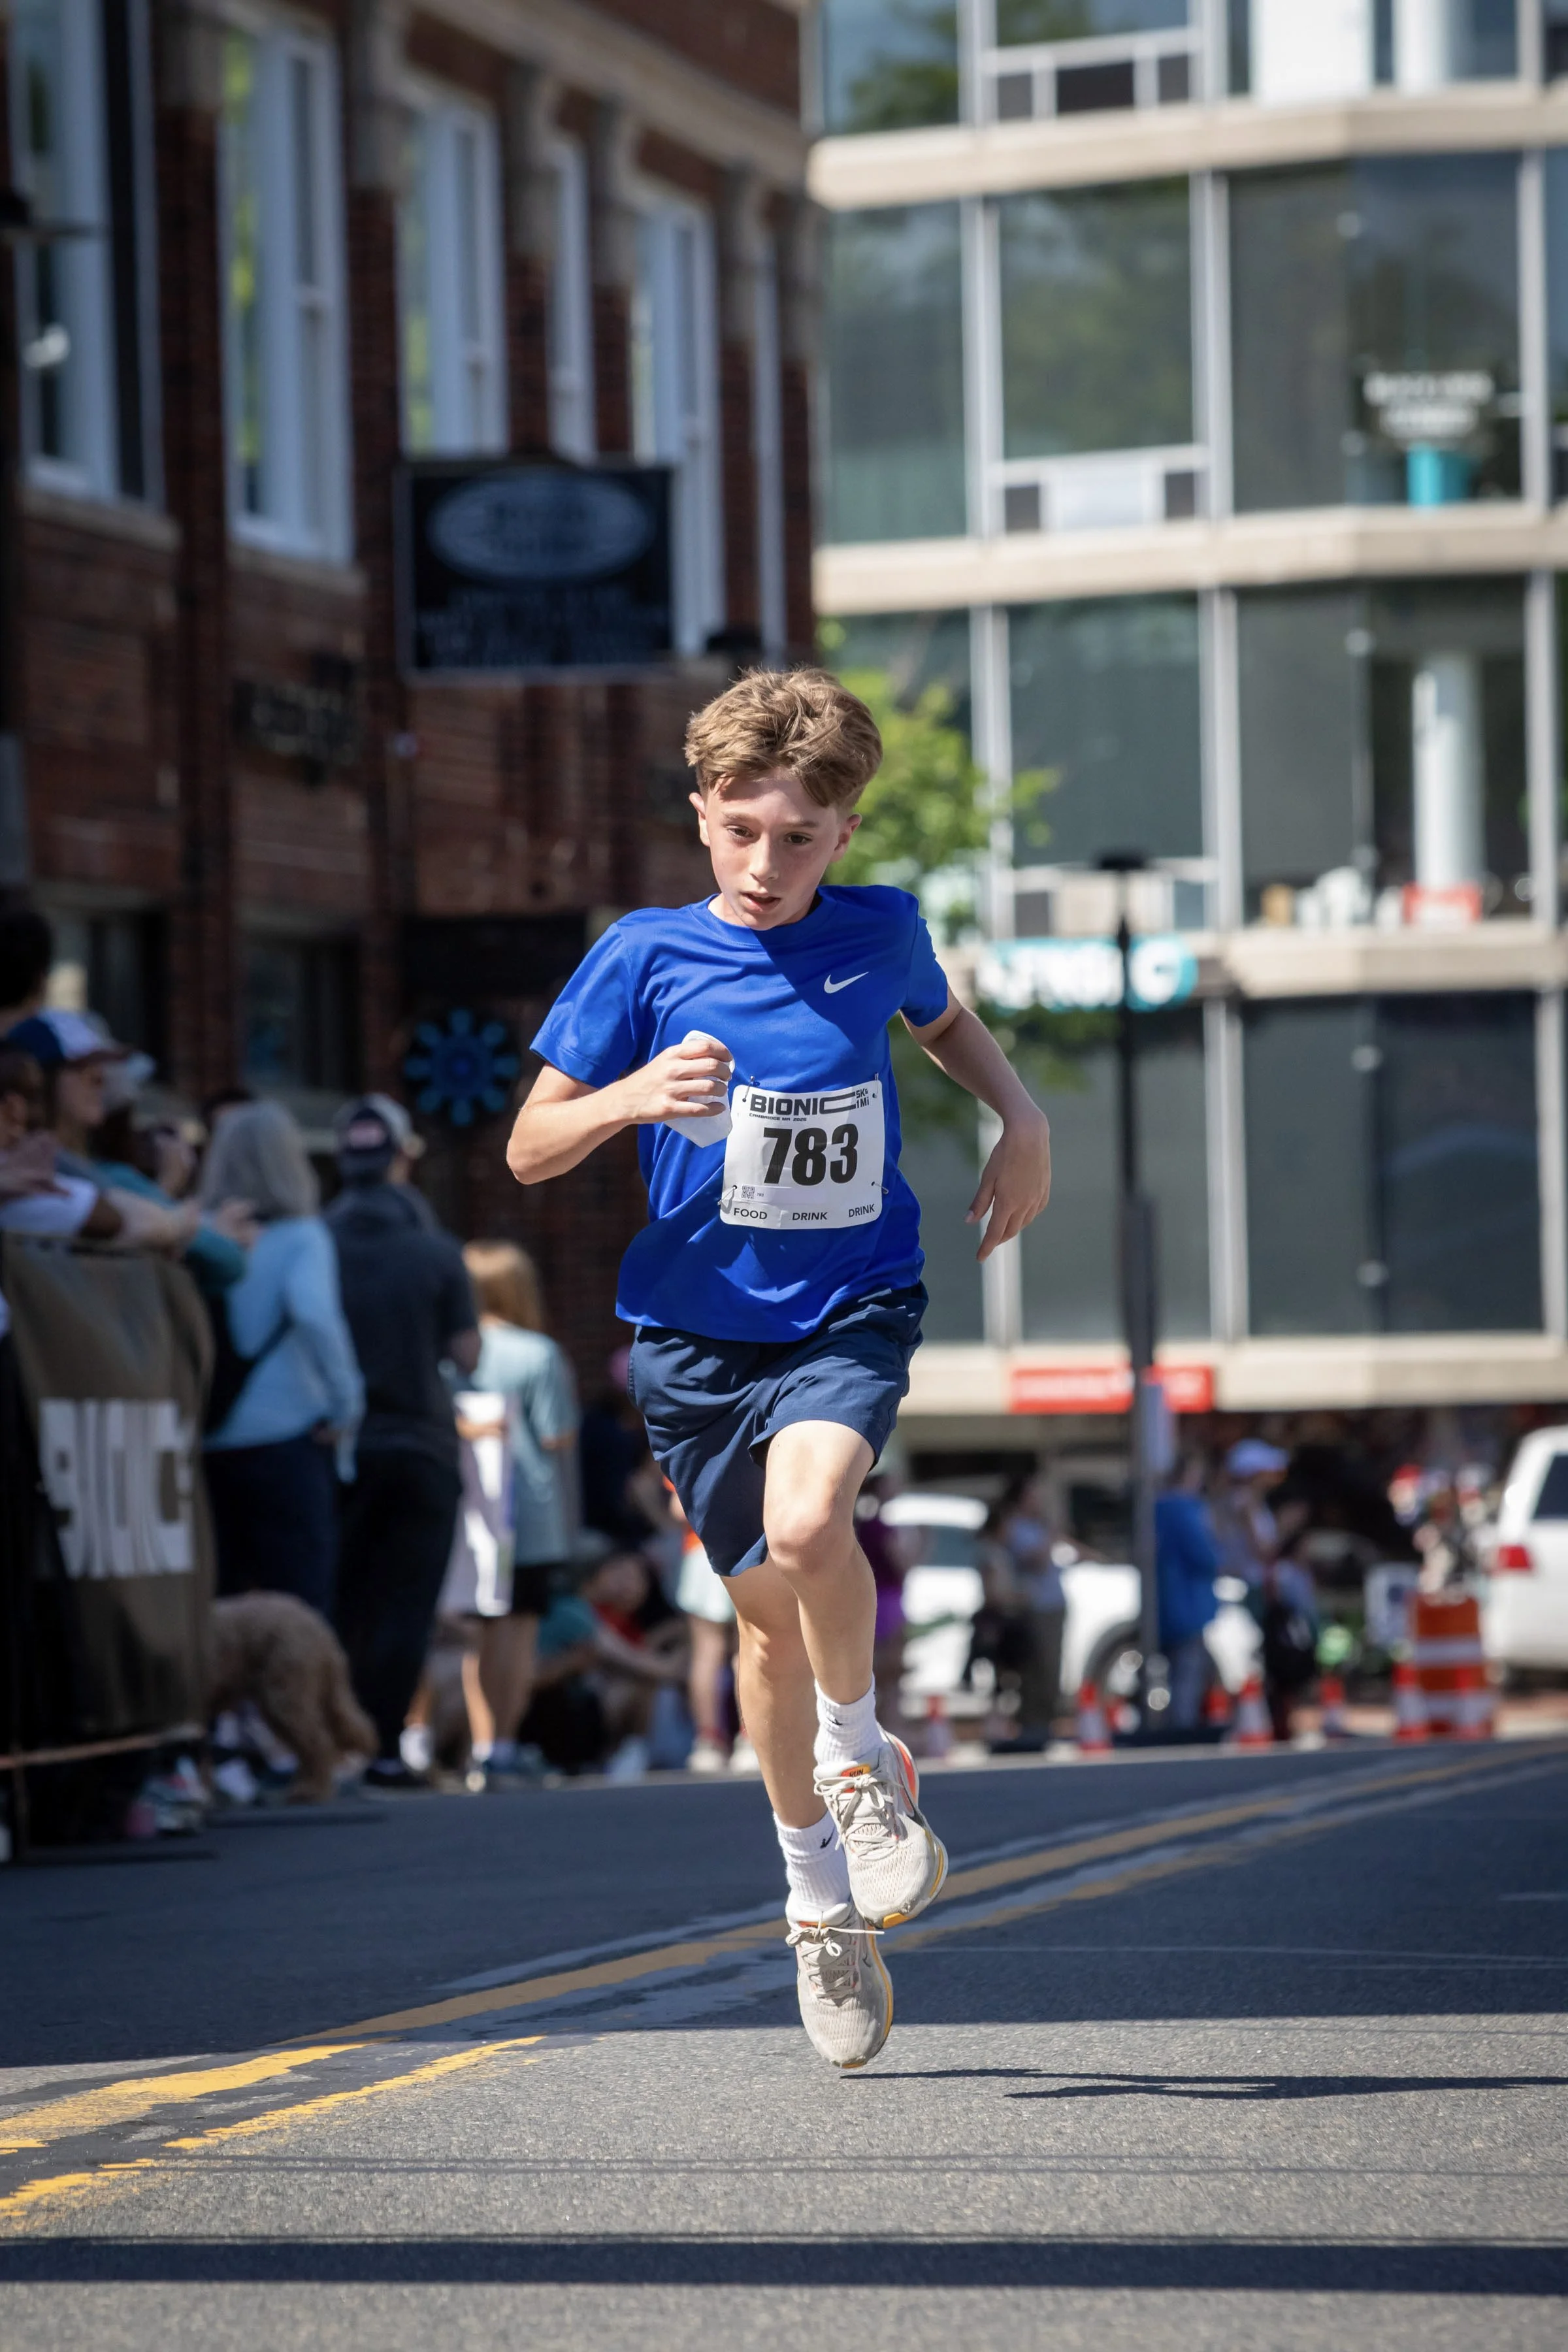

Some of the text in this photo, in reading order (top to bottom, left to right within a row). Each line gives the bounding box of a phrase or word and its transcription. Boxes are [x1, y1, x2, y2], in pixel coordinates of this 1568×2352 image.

[750, 1092, 856, 1116] BIONIC
[763, 1123, 858, 1186] 783
[734, 1207, 768, 1220] FOOD
[792, 1212, 828, 1220] DRINK
[848, 1203, 875, 1218] DRINK
